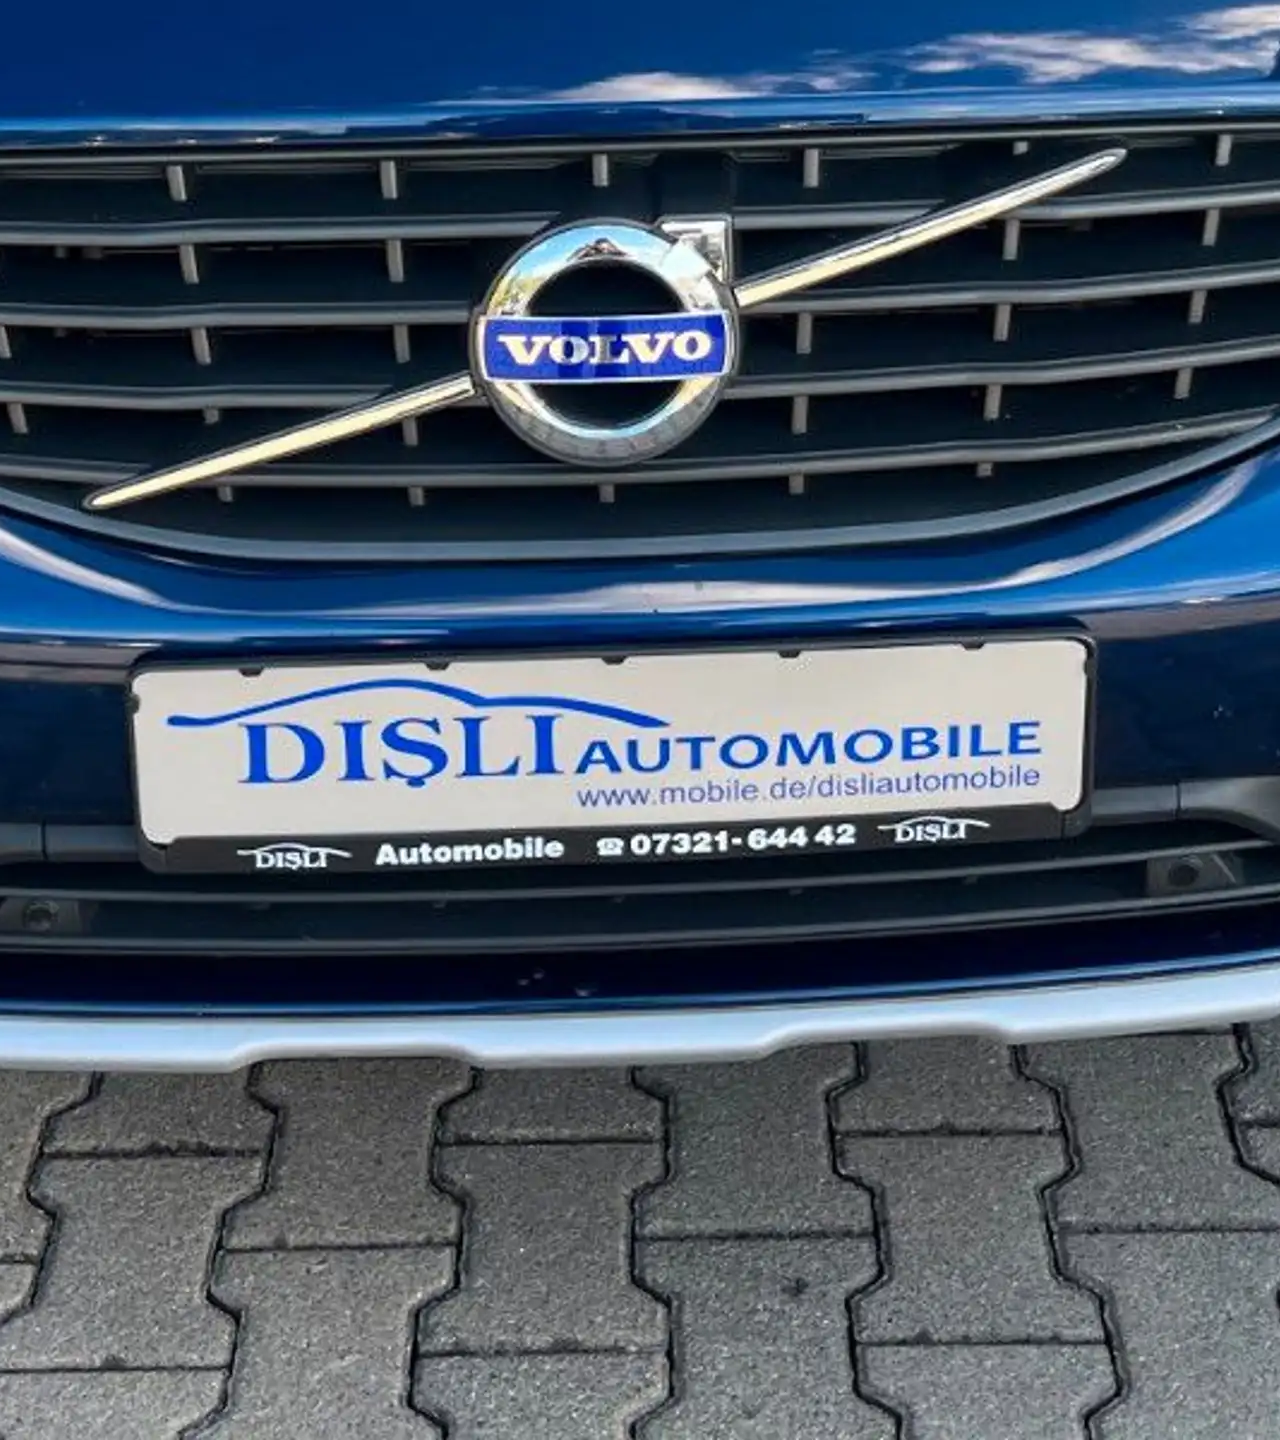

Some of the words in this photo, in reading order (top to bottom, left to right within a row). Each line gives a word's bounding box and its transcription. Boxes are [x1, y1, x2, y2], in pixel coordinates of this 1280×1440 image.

[497, 329, 715, 367] VOLVO
[237, 713, 564, 789] DIŞLI
[575, 720, 1042, 777] AUTOMOBILE
[576, 766, 1041, 808] www.mobile.de/disliautomobile
[374, 836, 565, 866] Automobile
